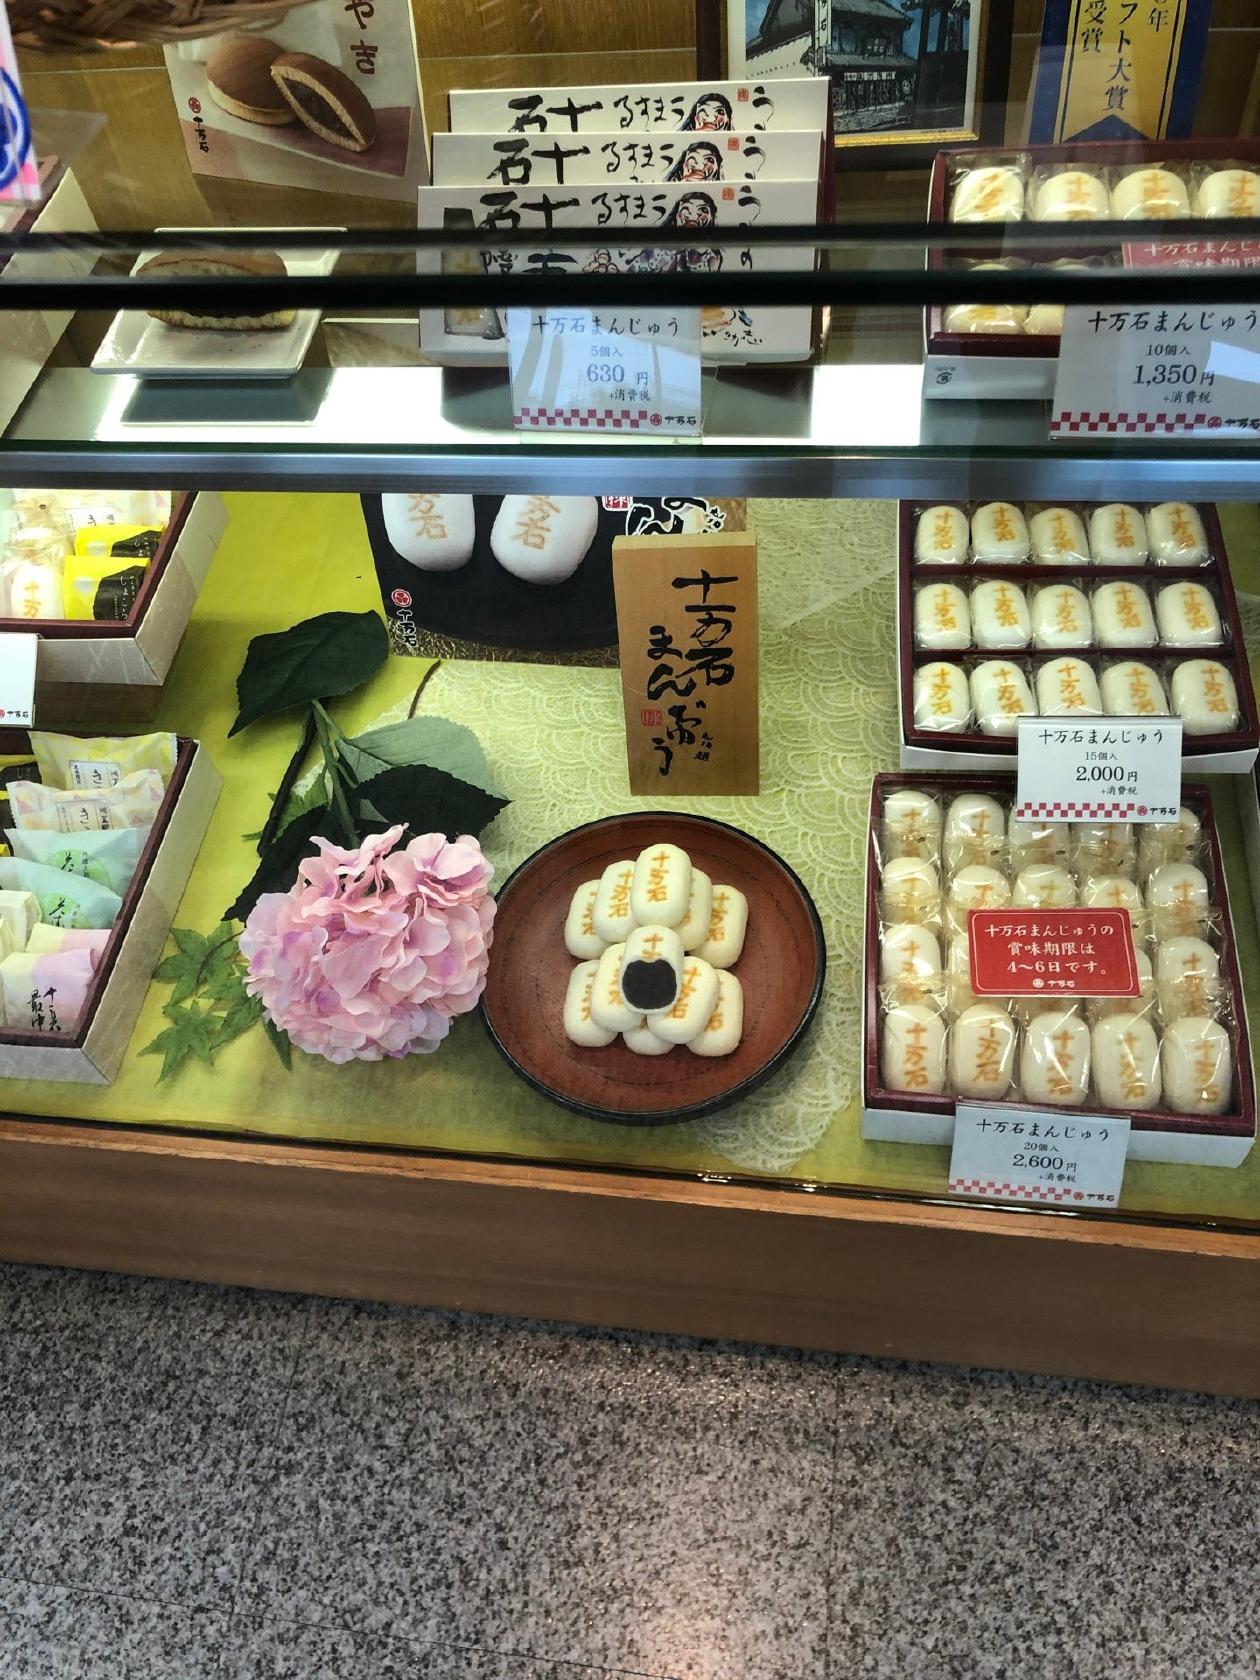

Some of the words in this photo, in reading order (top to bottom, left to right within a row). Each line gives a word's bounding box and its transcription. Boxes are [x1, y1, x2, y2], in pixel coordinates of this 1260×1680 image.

[1081, 1, 1109, 53] 受賞
[1102, 1, 1138, 111] フト大賞
[1144, 241, 1260, 256] 十万石まんじ
[532, 315, 680, 337] 十万石まんじゅう
[1088, 311, 1257, 333] 十万石まんじゅう
[591, 345, 623, 358] 5個入
[1146, 344, 1192, 357] 10個入
[664, 415, 697, 426] 十万石
[1224, 418, 1260, 430] 十万石
[24, 581, 42, 618] 十万
[672, 569, 739, 686] 十万石
[930, 668, 952, 715] 十万石
[993, 668, 1025, 714] 十万石
[1057, 663, 1088, 708] 十万石
[1202, 666, 1229, 713] 十万石
[1038, 728, 1164, 745] 十万石まんじゅう
[1085, 751, 1118, 761] 15個入
[1076, 766, 1138, 782] 2,000円
[1149, 807, 1177, 816] 十万石
[647, 851, 670, 902] 十万石
[984, 924, 1114, 938] 十万石まんじゅうの
[1008, 942, 1096, 956] 賞味期限は
[904, 1022, 928, 1088] 十万石
[973, 1018, 1001, 1083] 十万石
[976, 1118, 1109, 1141] 十万石まんじゅう
[1023, 1142, 1060, 1152] 20個入
[1086, 1193, 1115, 1202] 十万石
